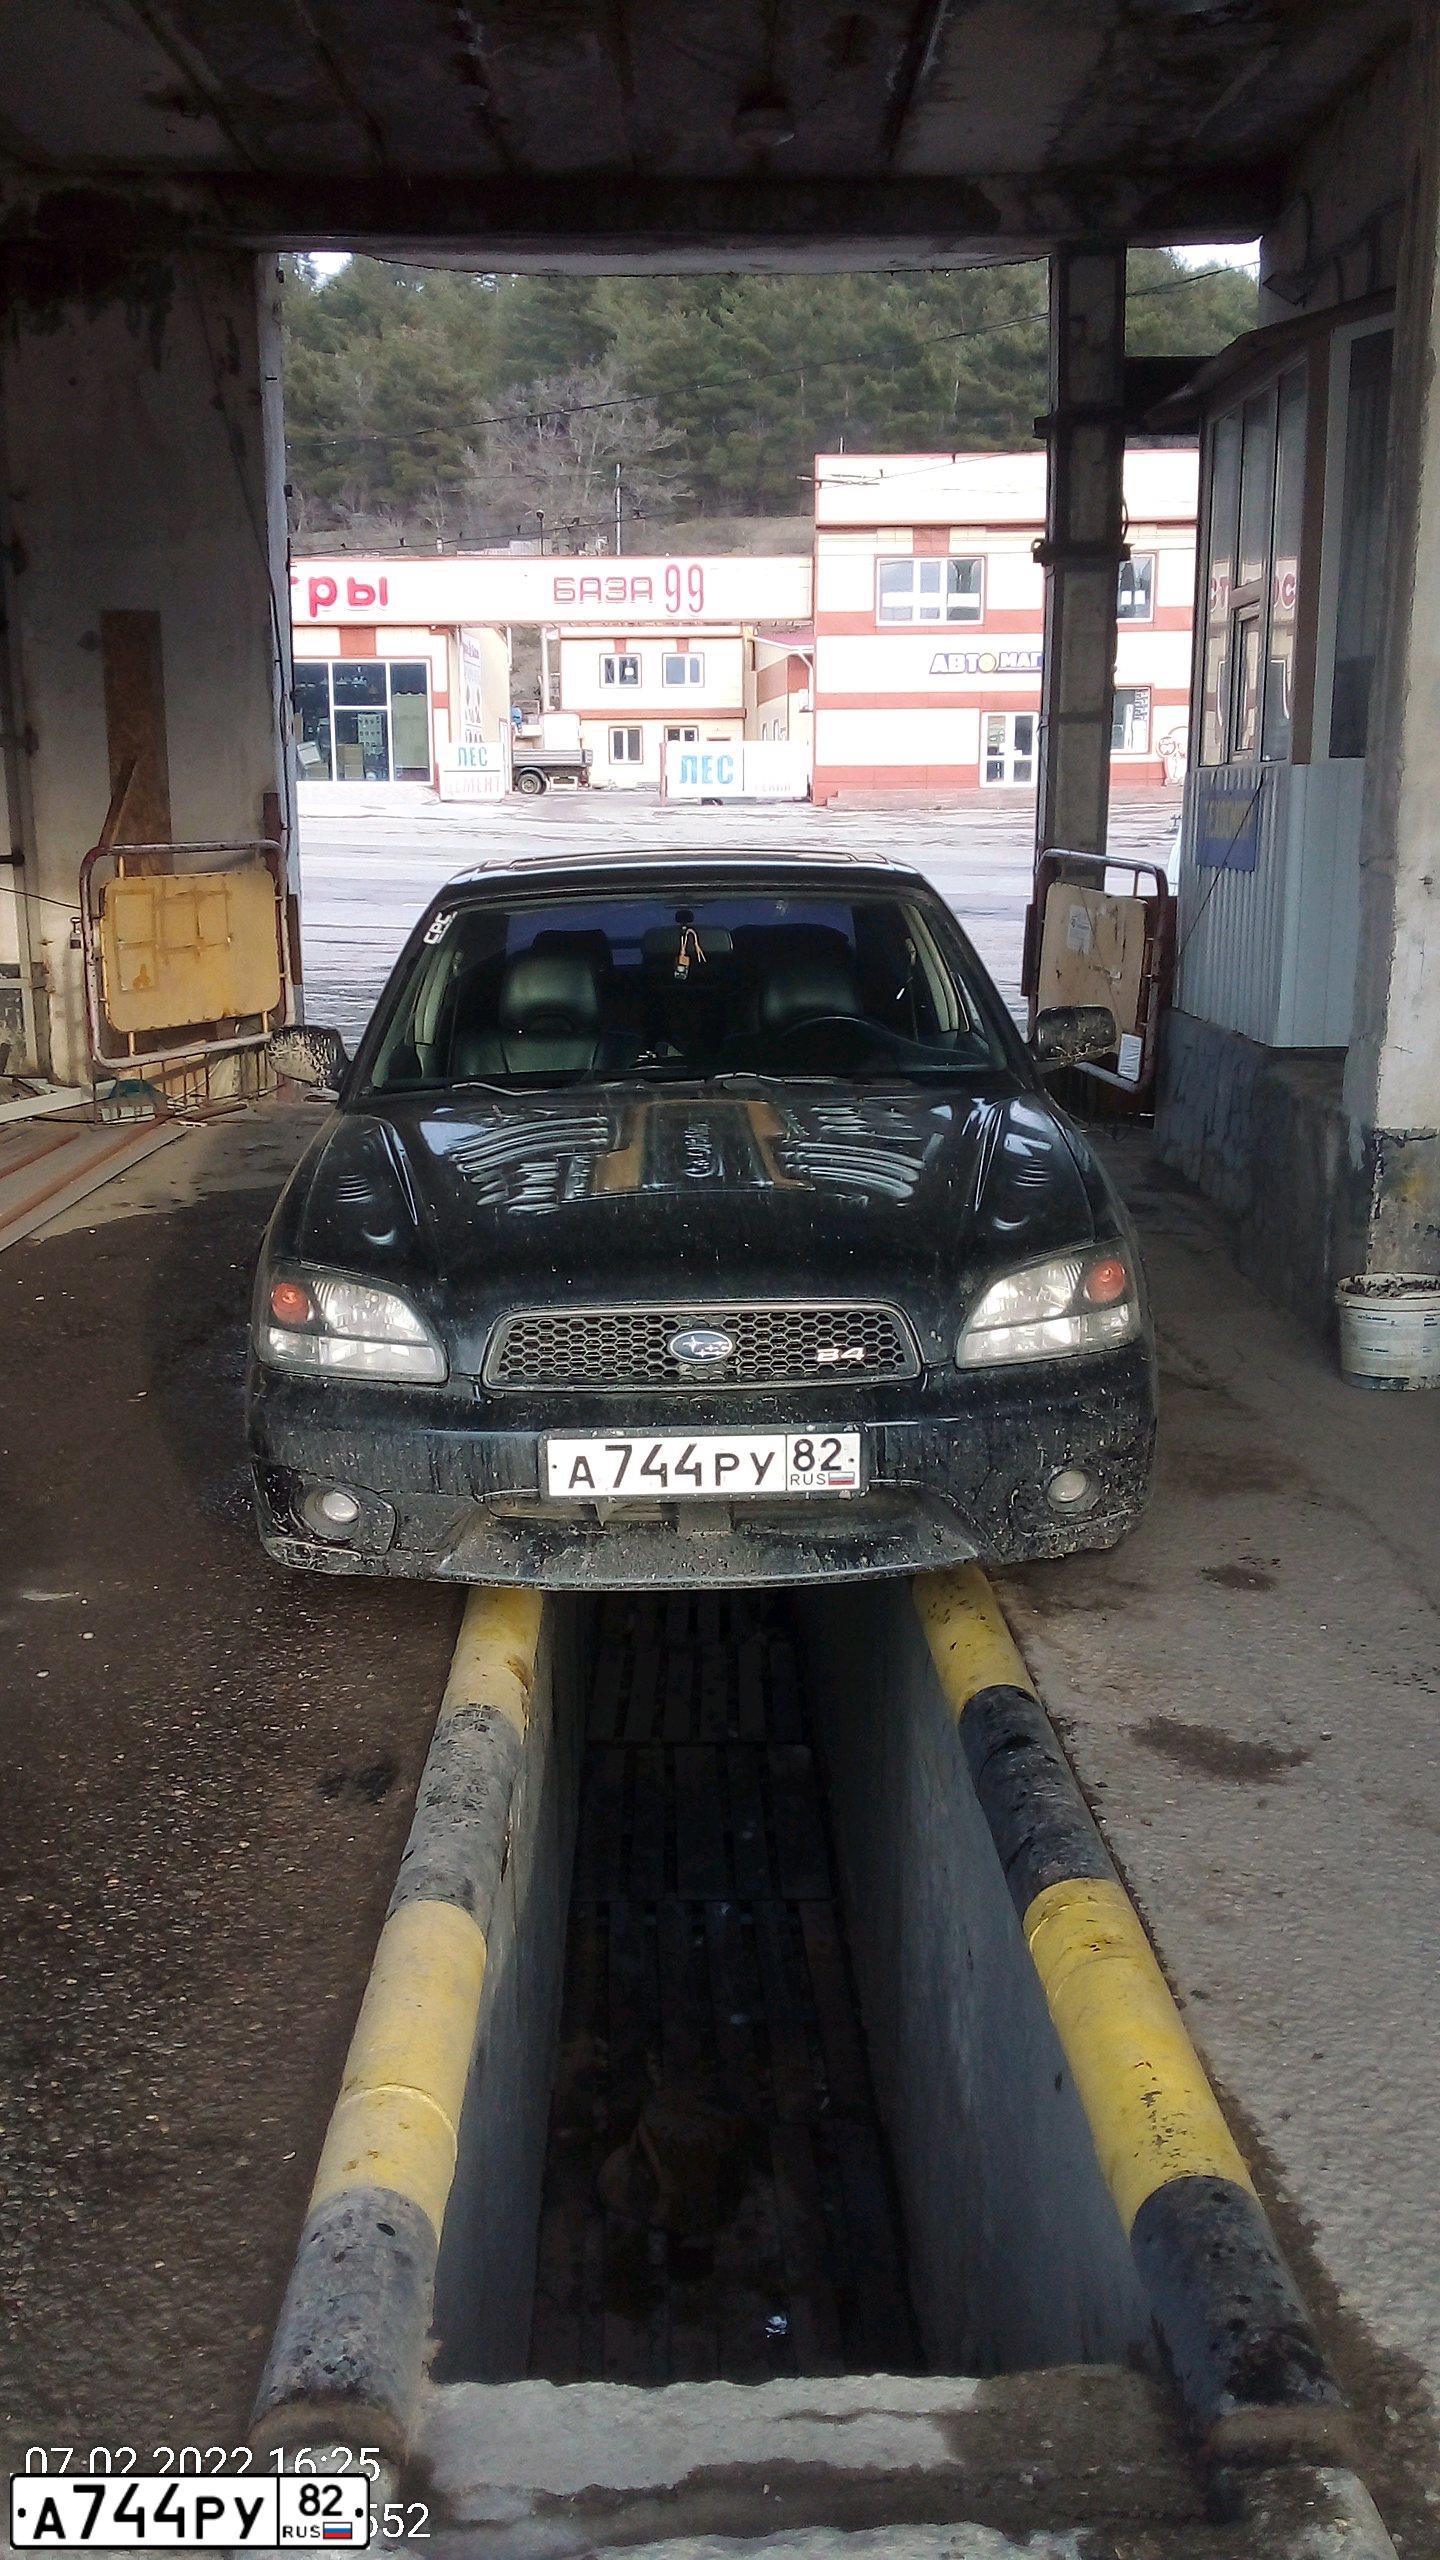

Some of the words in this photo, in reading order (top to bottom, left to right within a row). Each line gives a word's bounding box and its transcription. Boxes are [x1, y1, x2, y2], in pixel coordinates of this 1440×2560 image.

[290, 576, 388, 617] ры
[554, 577, 653, 601] БАЗА
[665, 564, 704, 613] 99
[458, 746, 488, 767] ЛЕС
[680, 754, 734, 785] ЛЕС
[816, 1347, 866, 1362] B4
[568, 1443, 775, 1489] А744РУ
[793, 1438, 842, 1472] 82
[790, 1472, 826, 1486] RUS
